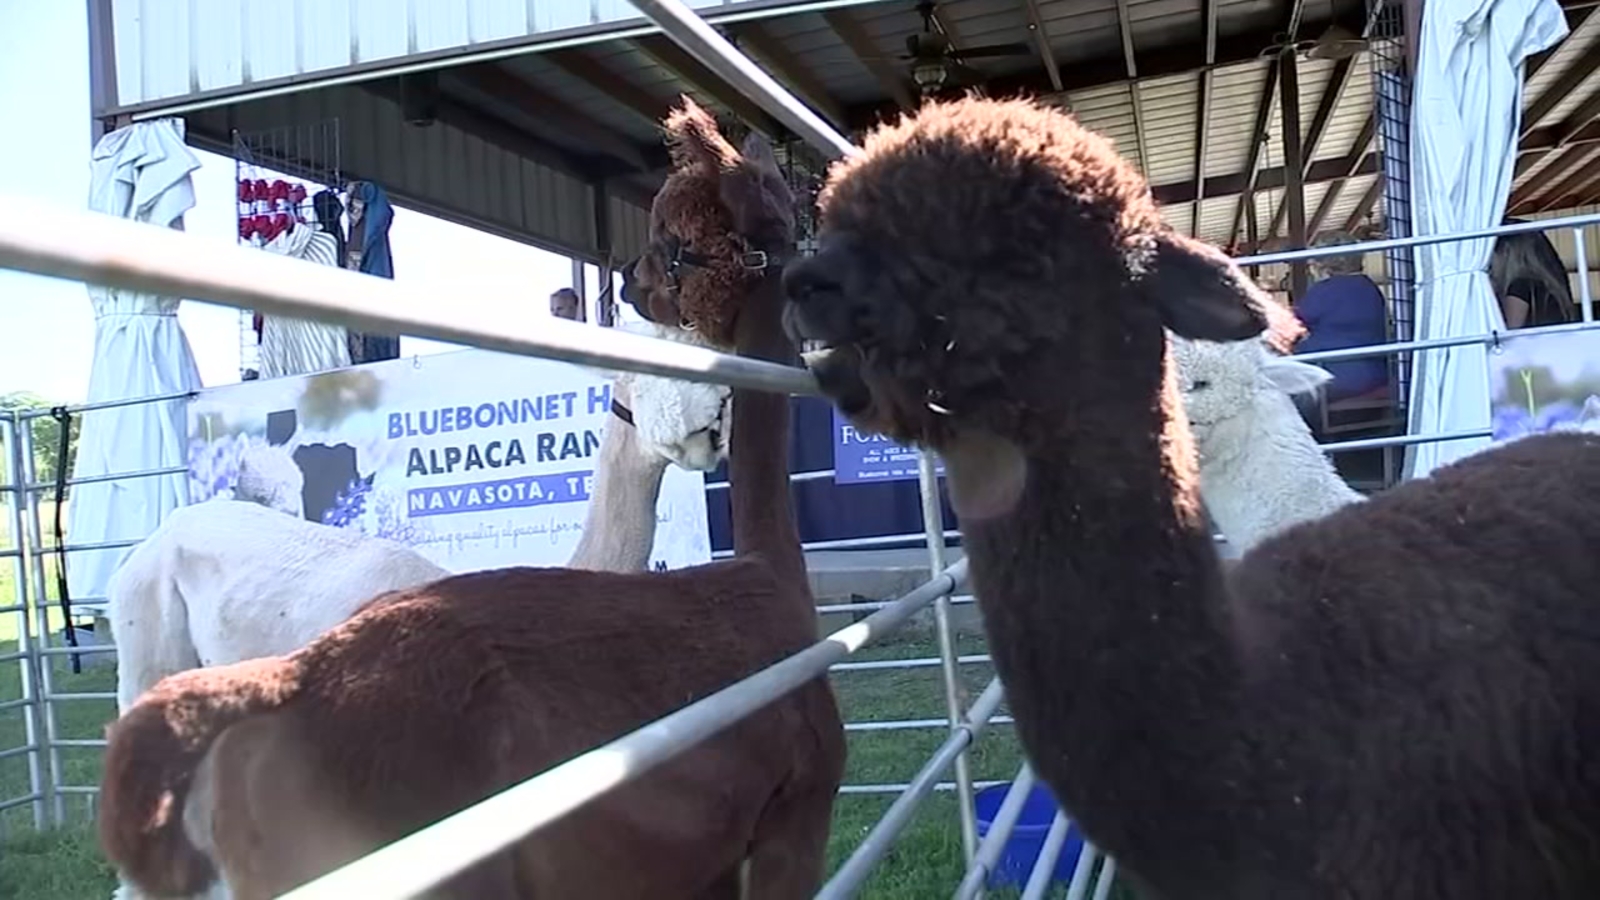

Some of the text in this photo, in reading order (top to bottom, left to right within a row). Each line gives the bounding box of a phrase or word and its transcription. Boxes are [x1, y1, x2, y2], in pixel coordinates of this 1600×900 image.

[387, 392, 578, 439] BLUEBONNET
[406, 438, 526, 478] ALPACA
[410, 480, 555, 511] NAVASOTA,
